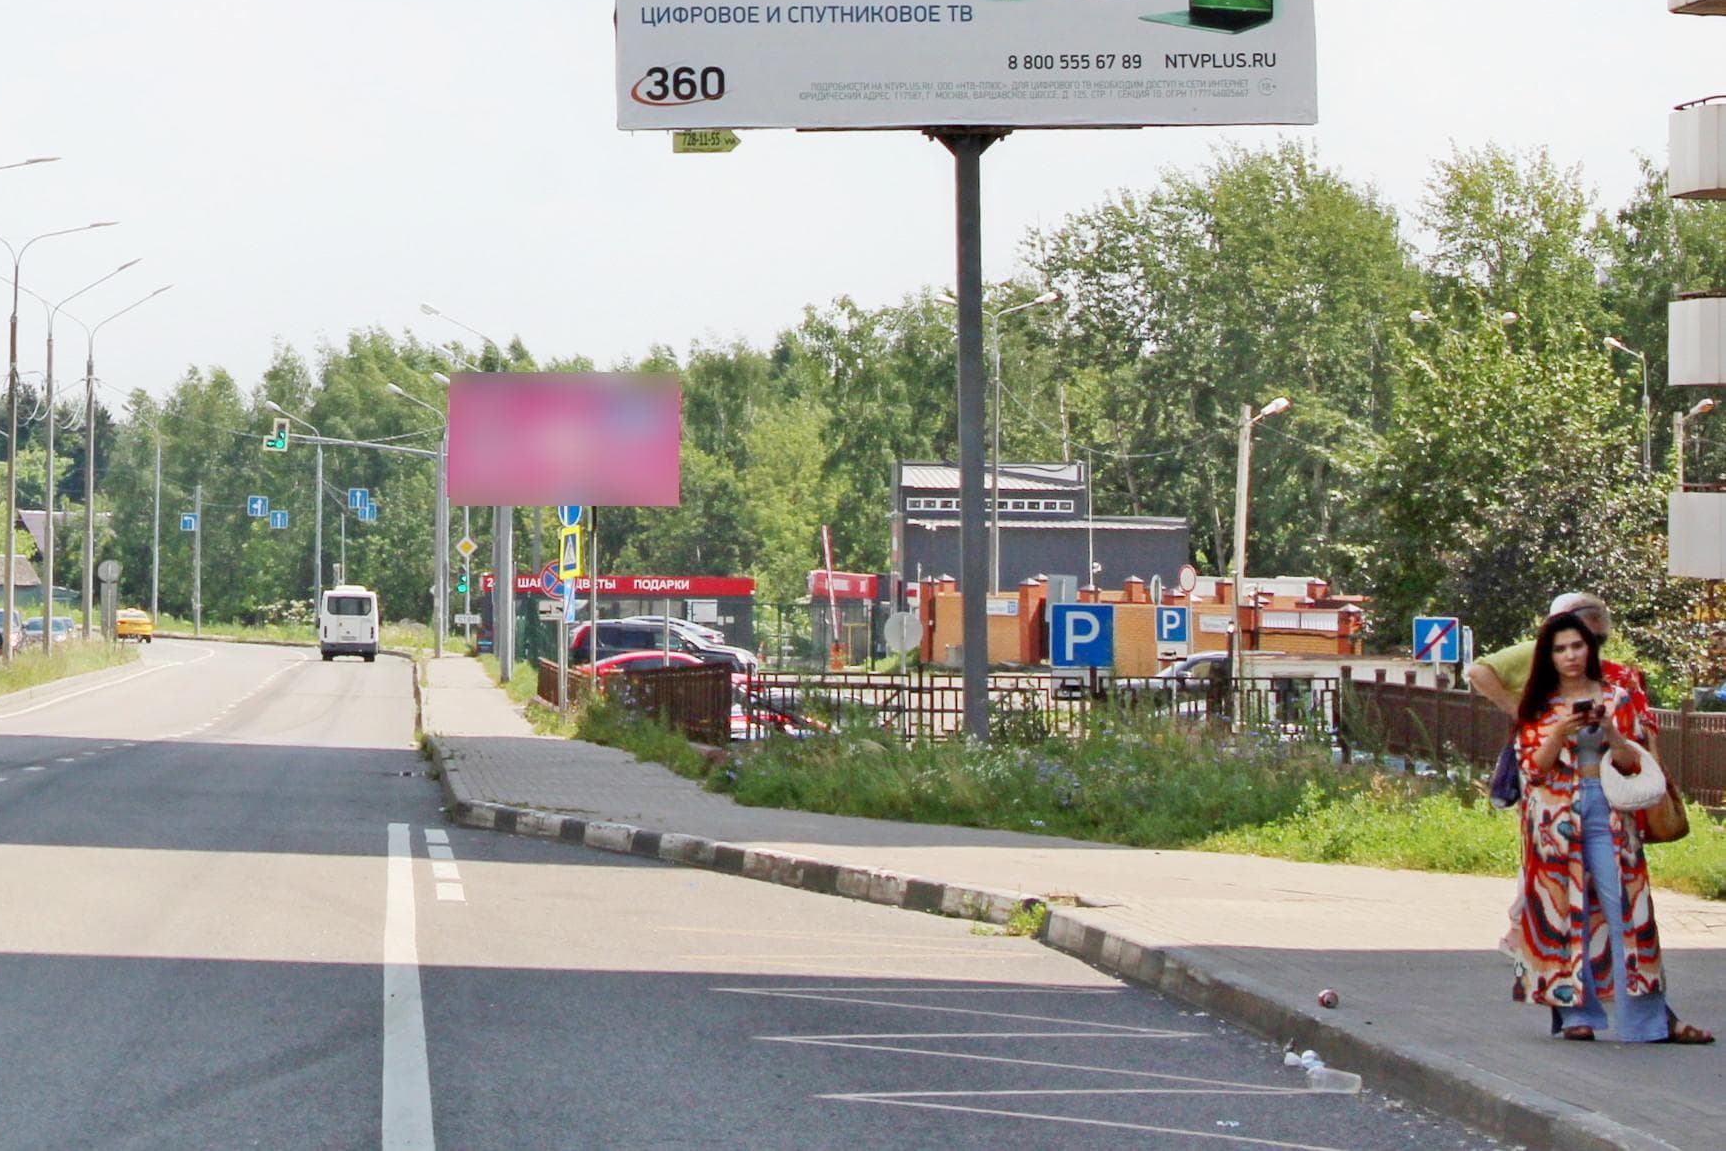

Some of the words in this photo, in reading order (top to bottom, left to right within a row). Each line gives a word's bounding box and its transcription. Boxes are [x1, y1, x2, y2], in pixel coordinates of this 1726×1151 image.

[640, 5, 760, 27] ЦИФРОВОЕ
[766, 5, 781, 24] И
[787, 4, 941, 24] СПУТНИКОВОЕ
[946, 3, 973, 23] ТВ
[1007, 54, 1018, 70] 8
[1023, 54, 1054, 70] 800
[1059, 54, 1091, 70] 555
[1095, 54, 1116, 70] 67
[1121, 54, 1142, 70] 89
[1165, 52, 1276, 69] NTVPLUS.RU
[645, 66, 725, 101] 360
[633, 579, 691, 592] ПОДАРКИ
[1065, 611, 1100, 660] P
[1162, 610, 1183, 638] P
